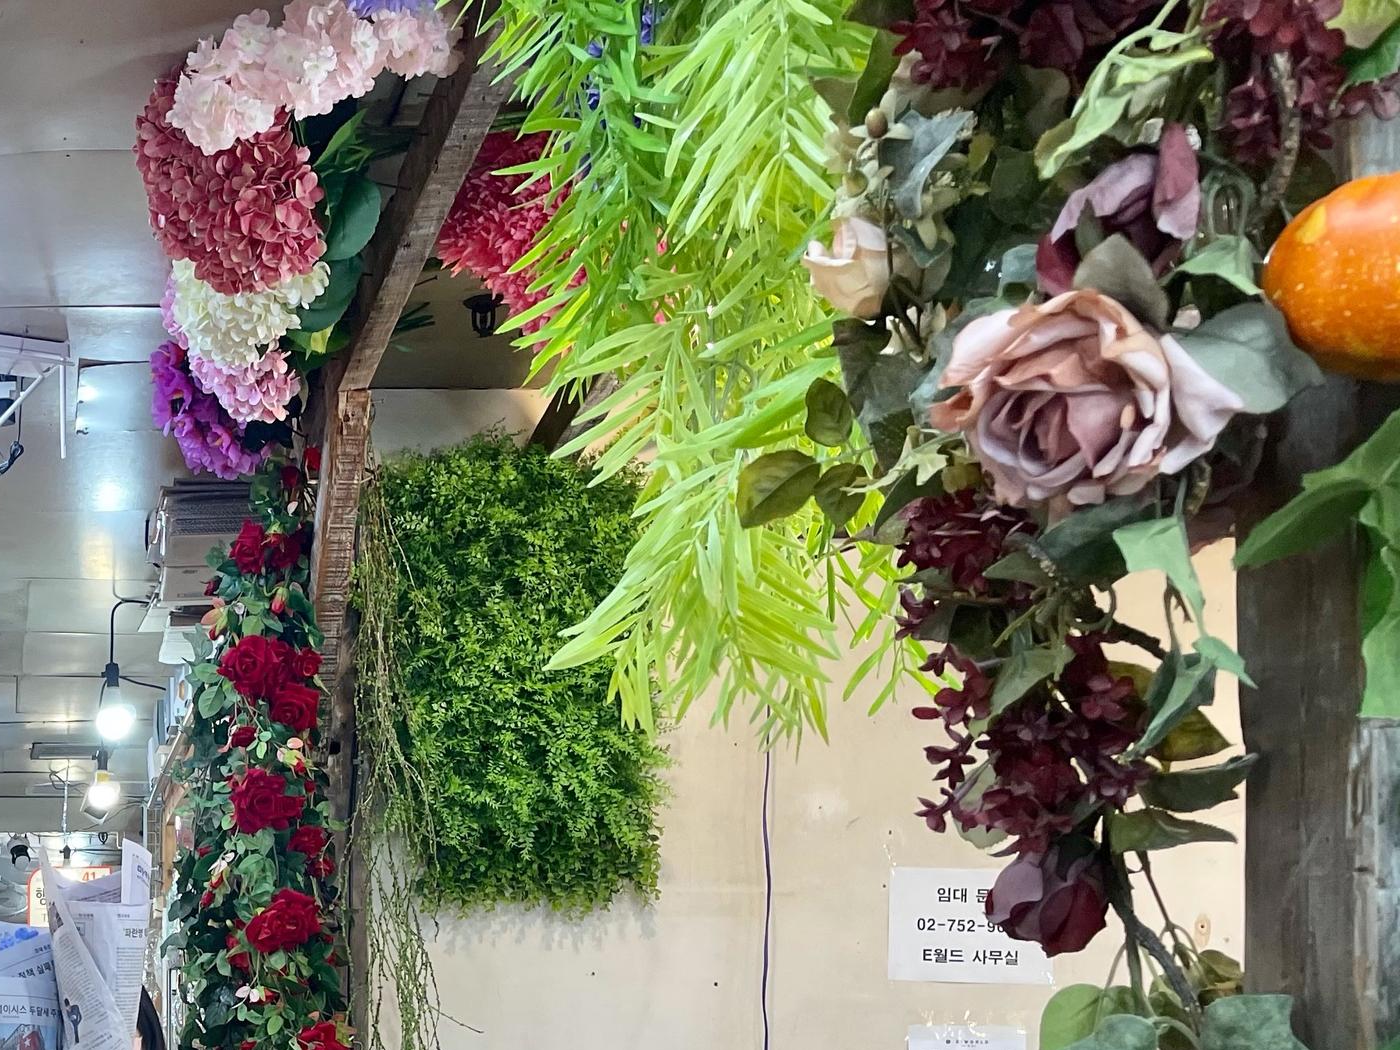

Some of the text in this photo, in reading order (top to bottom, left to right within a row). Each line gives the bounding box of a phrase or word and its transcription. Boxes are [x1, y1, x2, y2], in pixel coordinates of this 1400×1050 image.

[937, 887, 968, 903] 임대
[922, 948, 1019, 965] E월드 사무실
